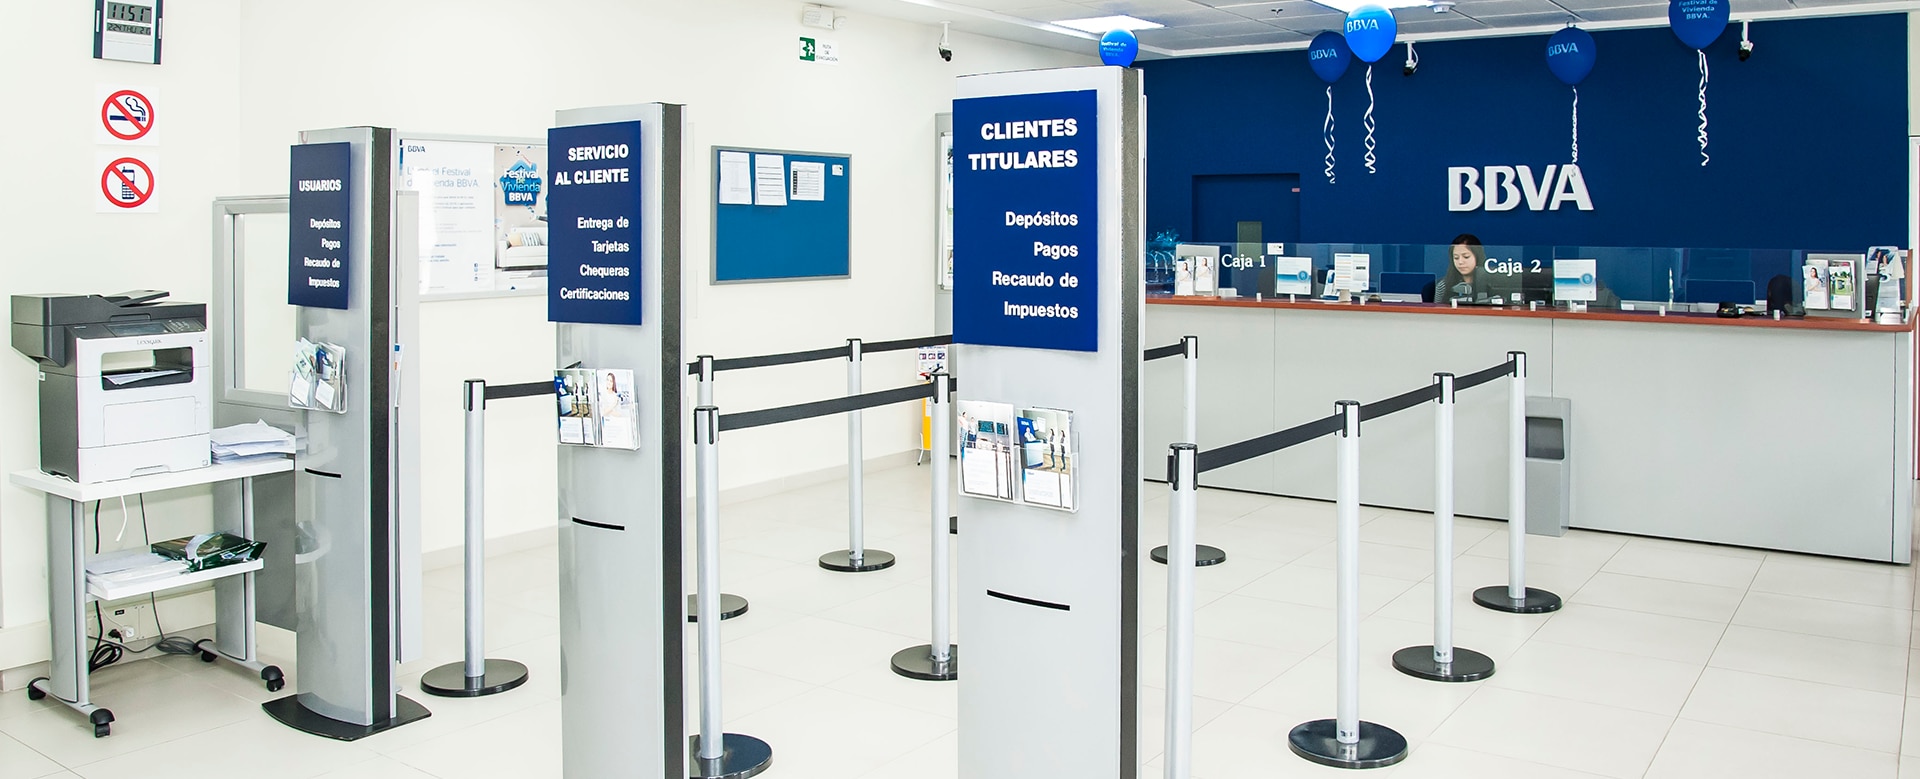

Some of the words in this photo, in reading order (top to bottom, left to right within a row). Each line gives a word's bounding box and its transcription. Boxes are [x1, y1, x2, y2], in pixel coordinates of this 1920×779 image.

[1346, 19, 1379, 33] BBVA
[1310, 48, 1338, 60] BBVA
[1548, 42, 1579, 57] BBVA
[980, 117, 1078, 140] CLIENTES
[407, 145, 426, 153] BBVA
[567, 143, 630, 162] SERVICIO
[967, 149, 1078, 171] TITULARES
[441, 166, 471, 176] Festival
[504, 168, 539, 178] Festival
[554, 171, 572, 185] AL
[573, 168, 630, 185] CLIENTE
[298, 179, 342, 192] USUARIOS
[456, 178, 479, 188] BBVA
[501, 182, 541, 192] Vivienda
[1447, 164, 1595, 212] BBVA
[508, 192, 534, 202] BBVA
[309, 218, 341, 230] Depósitos
[577, 216, 614, 231] Entrega
[616, 216, 630, 229] de
[1005, 211, 1079, 229] Depósitos
[321, 238, 341, 250] Pagos
[591, 240, 630, 254] Tarjetas
[1033, 241, 1079, 260] Pagos
[303, 257, 331, 268] Recaudo
[331, 258, 341, 268] de
[1221, 253, 1254, 271] Caja
[1259, 255, 1266, 267] 1
[1484, 258, 1523, 276] Caja
[1530, 259, 1542, 273] 2
[579, 264, 630, 278] Chequeras
[308, 276, 340, 288] Impuestos
[992, 270, 1054, 287] Recaudo
[1059, 272, 1079, 288] de
[559, 286, 630, 301] Certificaciones
[1003, 301, 1079, 319] Impuestos
